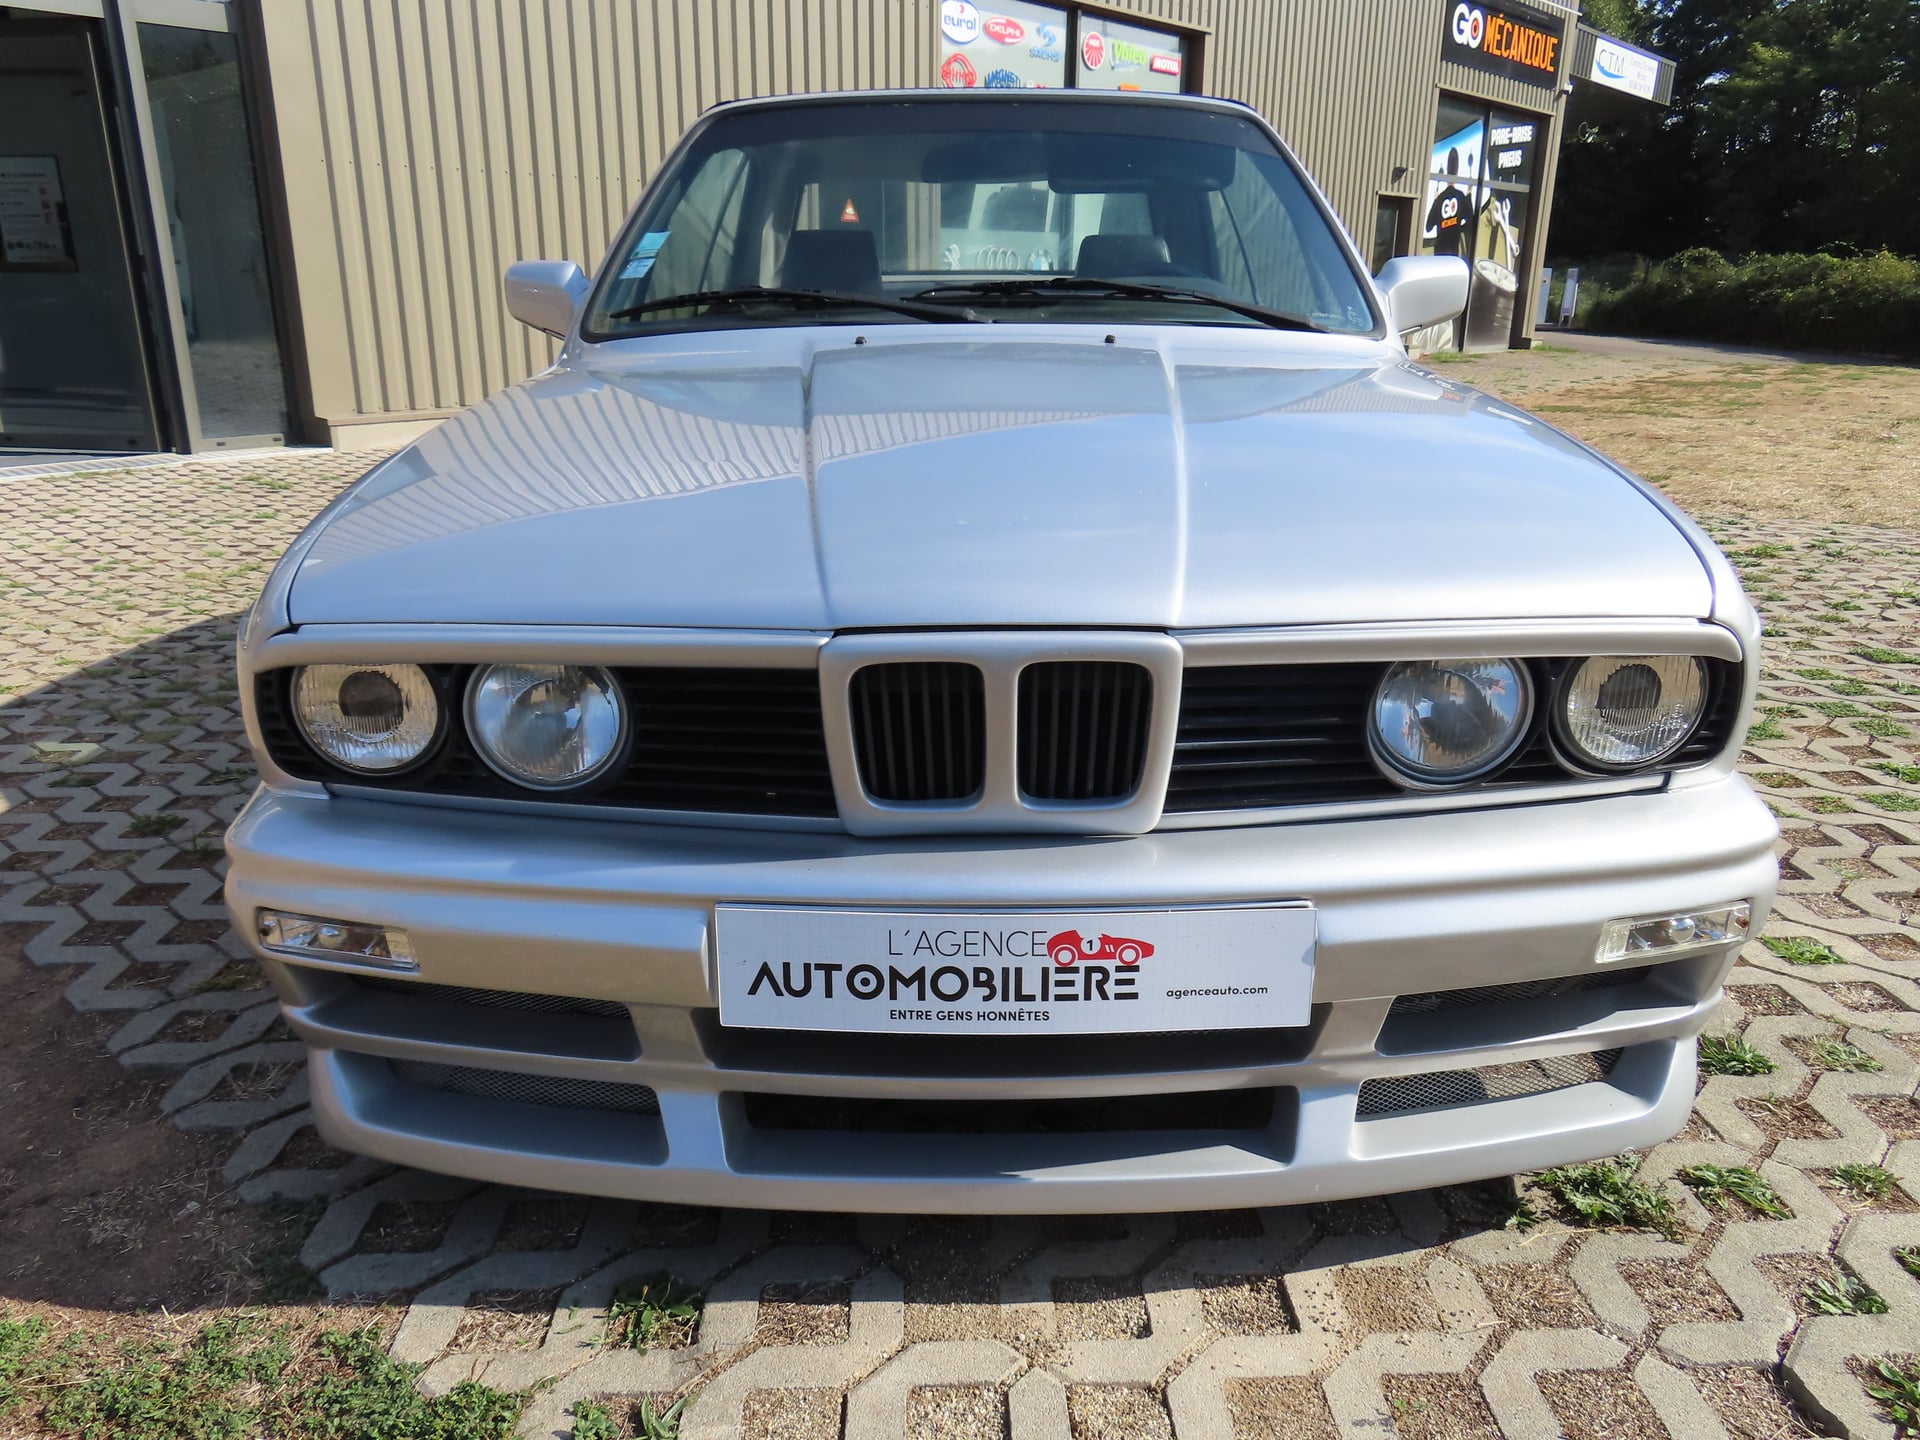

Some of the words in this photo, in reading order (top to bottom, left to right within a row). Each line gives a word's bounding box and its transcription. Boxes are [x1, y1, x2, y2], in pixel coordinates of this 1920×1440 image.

[943, 14, 977, 31] eurol
[989, 23, 1021, 37] DELPHI
[1452, 3, 1484, 49] GO
[1483, 13, 1559, 73] MÉCANIQUE
[1029, 47, 1061, 63] SACHS
[1598, 48, 1626, 75] CTM
[1153, 57, 1179, 72] MOTUL
[1490, 125, 1533, 146] PARE-BRISE
[1498, 149, 1523, 169] PNEUS
[1441, 197, 1458, 219] GO
[1085, 939, 1095, 952] 1
[1166, 986, 1269, 1000] agenceauto.com
[890, 1009, 933, 1021] ENTRE
[936, 1010, 973, 1022] GENS
[977, 1008, 1050, 1022] HONNÊTES
